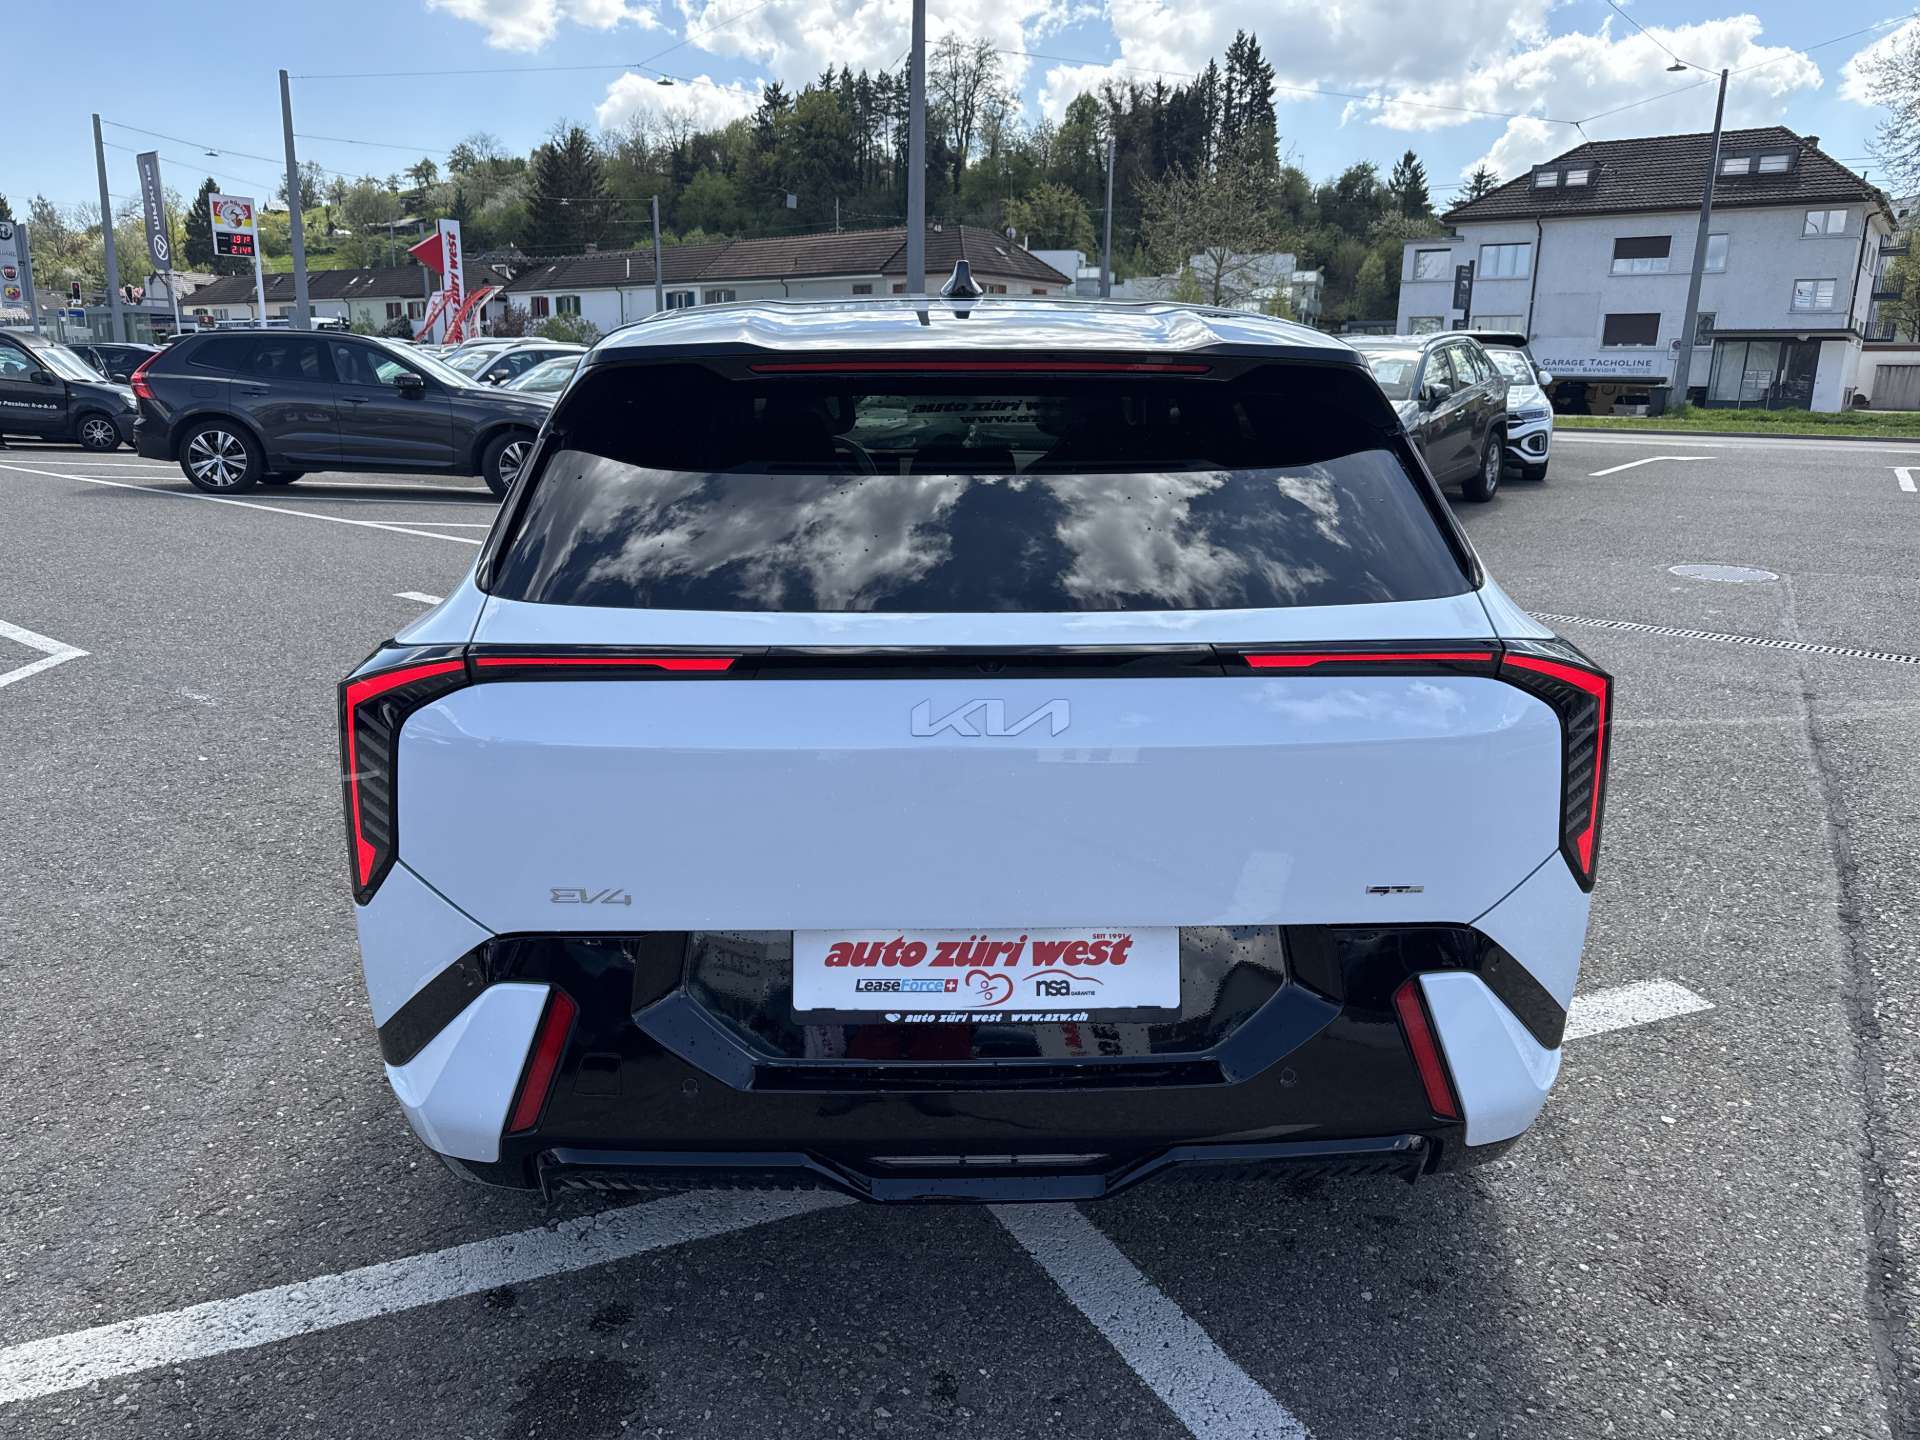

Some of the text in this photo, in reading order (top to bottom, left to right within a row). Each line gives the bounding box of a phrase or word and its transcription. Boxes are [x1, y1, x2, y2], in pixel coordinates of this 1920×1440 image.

[447, 231, 458, 270] west
[911, 698, 1071, 737] KIA
[550, 888, 632, 906] EV4
[824, 934, 1134, 968] auto züri west
[855, 979, 944, 993] LeaseForce
[1036, 979, 1070, 996] nsa
[904, 1011, 1089, 1023] auto züri west www.azw.ch
